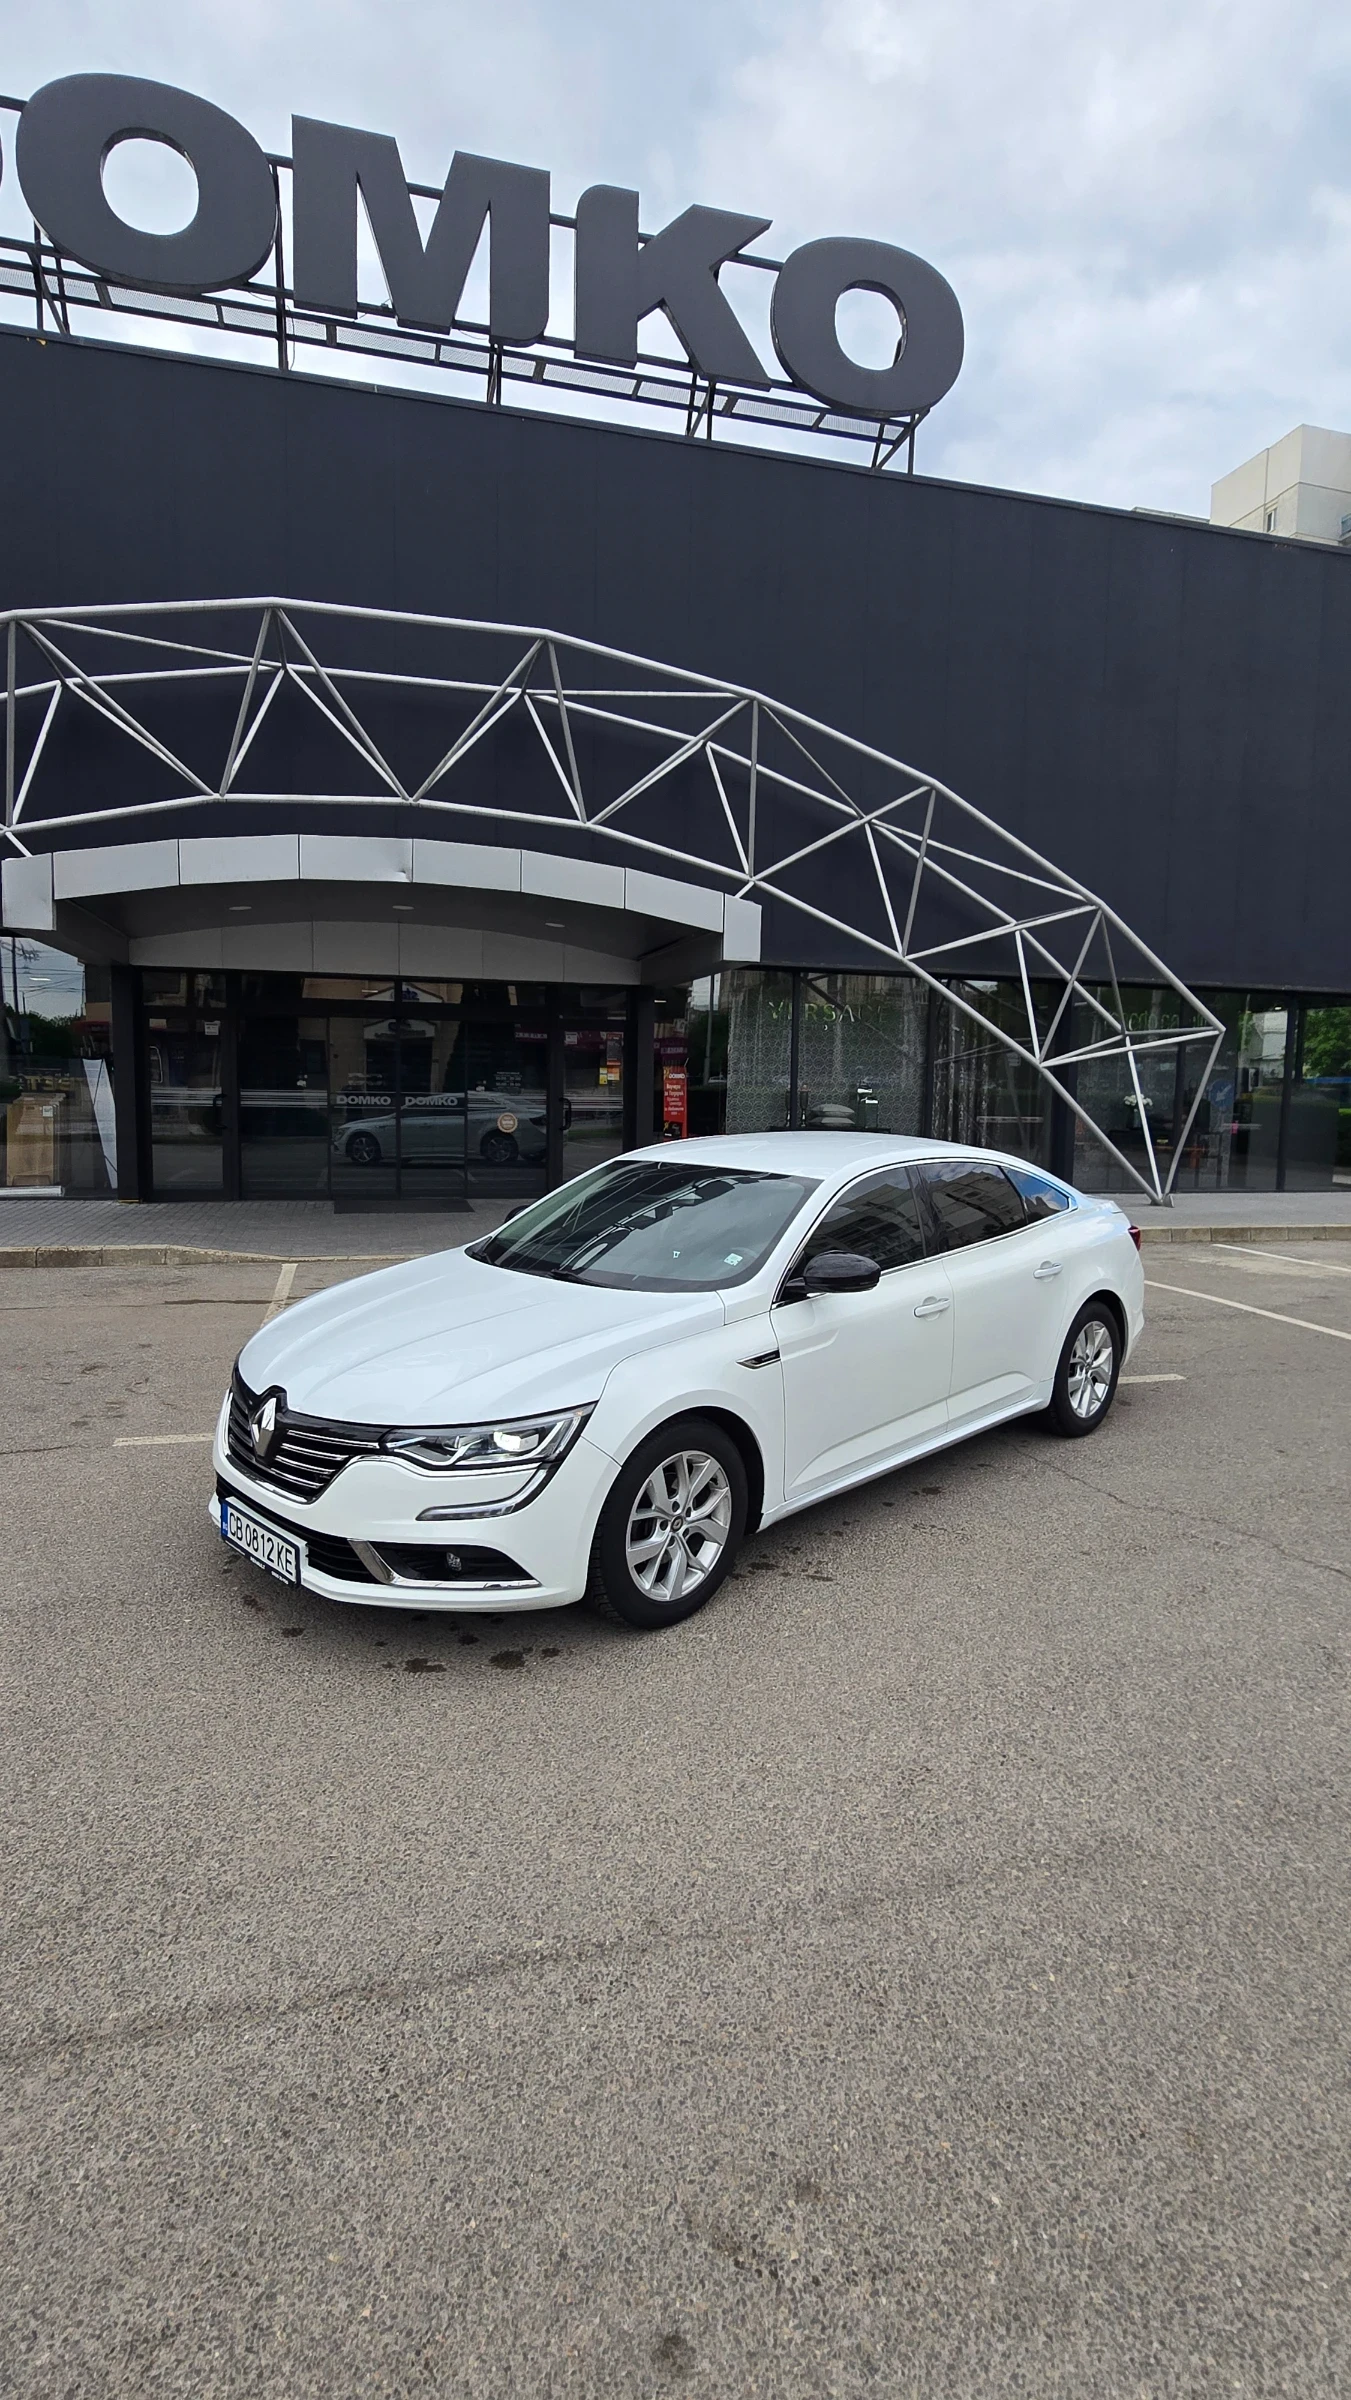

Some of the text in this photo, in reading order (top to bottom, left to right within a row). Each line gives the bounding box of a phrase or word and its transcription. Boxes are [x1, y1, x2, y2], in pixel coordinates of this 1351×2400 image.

[0, 72, 965, 418] OMKO
[336, 1094, 391, 1105] DOMKO
[405, 1096, 458, 1106] DOMKO
